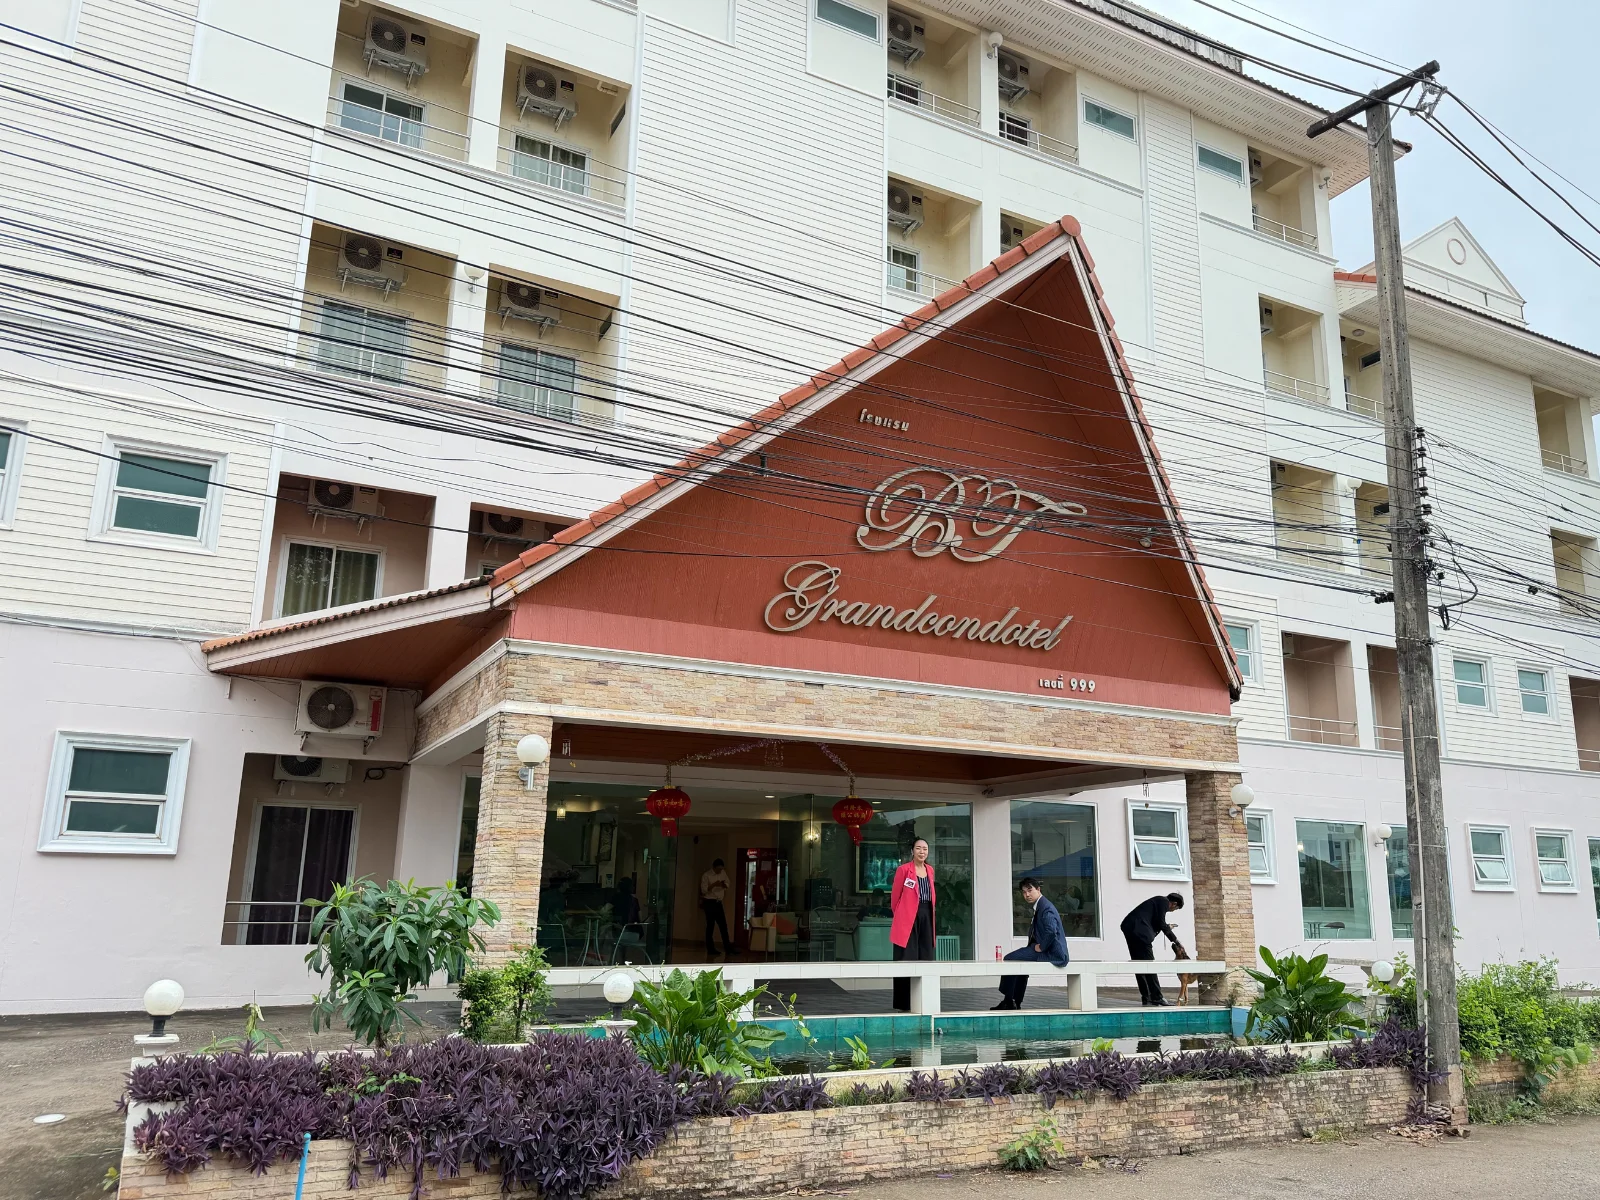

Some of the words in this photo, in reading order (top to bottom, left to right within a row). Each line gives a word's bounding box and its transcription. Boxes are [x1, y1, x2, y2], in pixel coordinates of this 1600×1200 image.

[859, 408, 910, 432] โรงแรม
[856, 466, 1088, 563] BT
[764, 560, 1074, 652] Grandcondotel
[1039, 674, 1064, 689] เลขที่
[1070, 677, 1096, 693] 999
